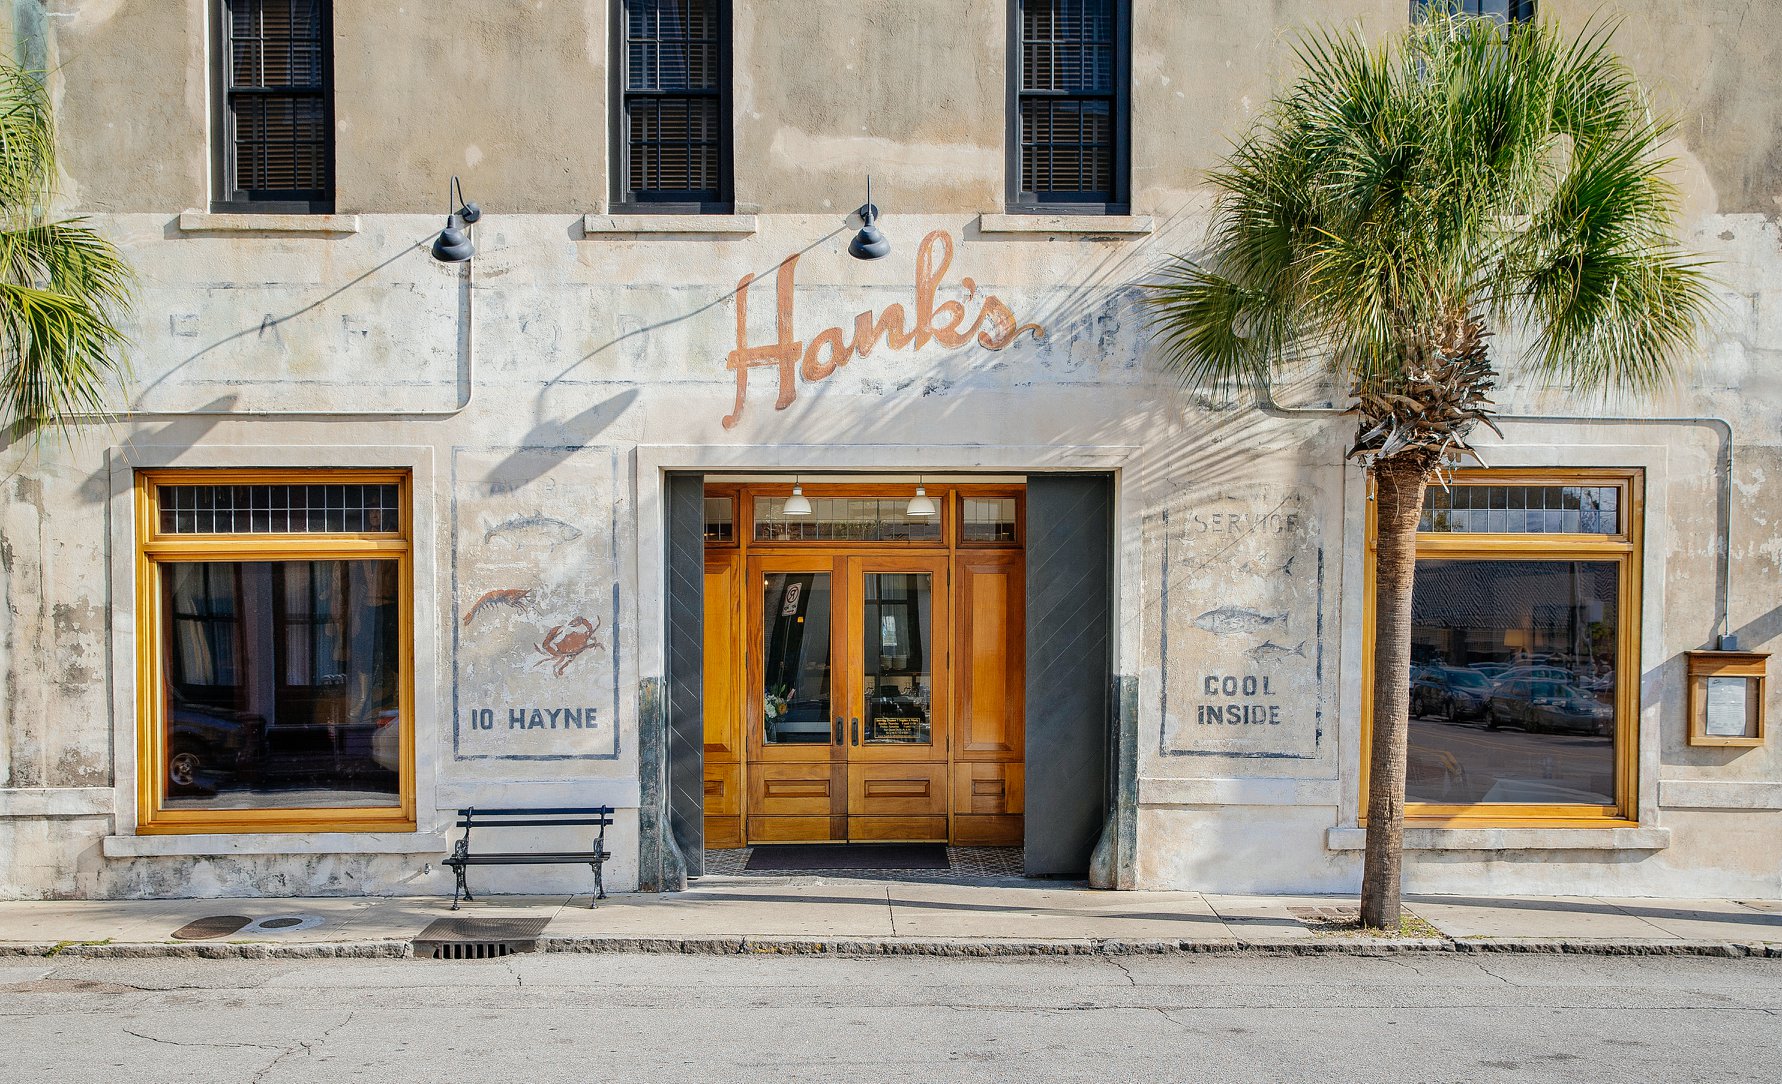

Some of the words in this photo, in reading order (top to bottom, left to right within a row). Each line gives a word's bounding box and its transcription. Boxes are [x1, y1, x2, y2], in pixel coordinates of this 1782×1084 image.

[722, 230, 1044, 431] Hank's
[1204, 676, 1276, 697] COOL
[472, 708, 494, 730] 10
[509, 708, 599, 730] HAYNE
[1197, 705, 1281, 726] INSIDE
